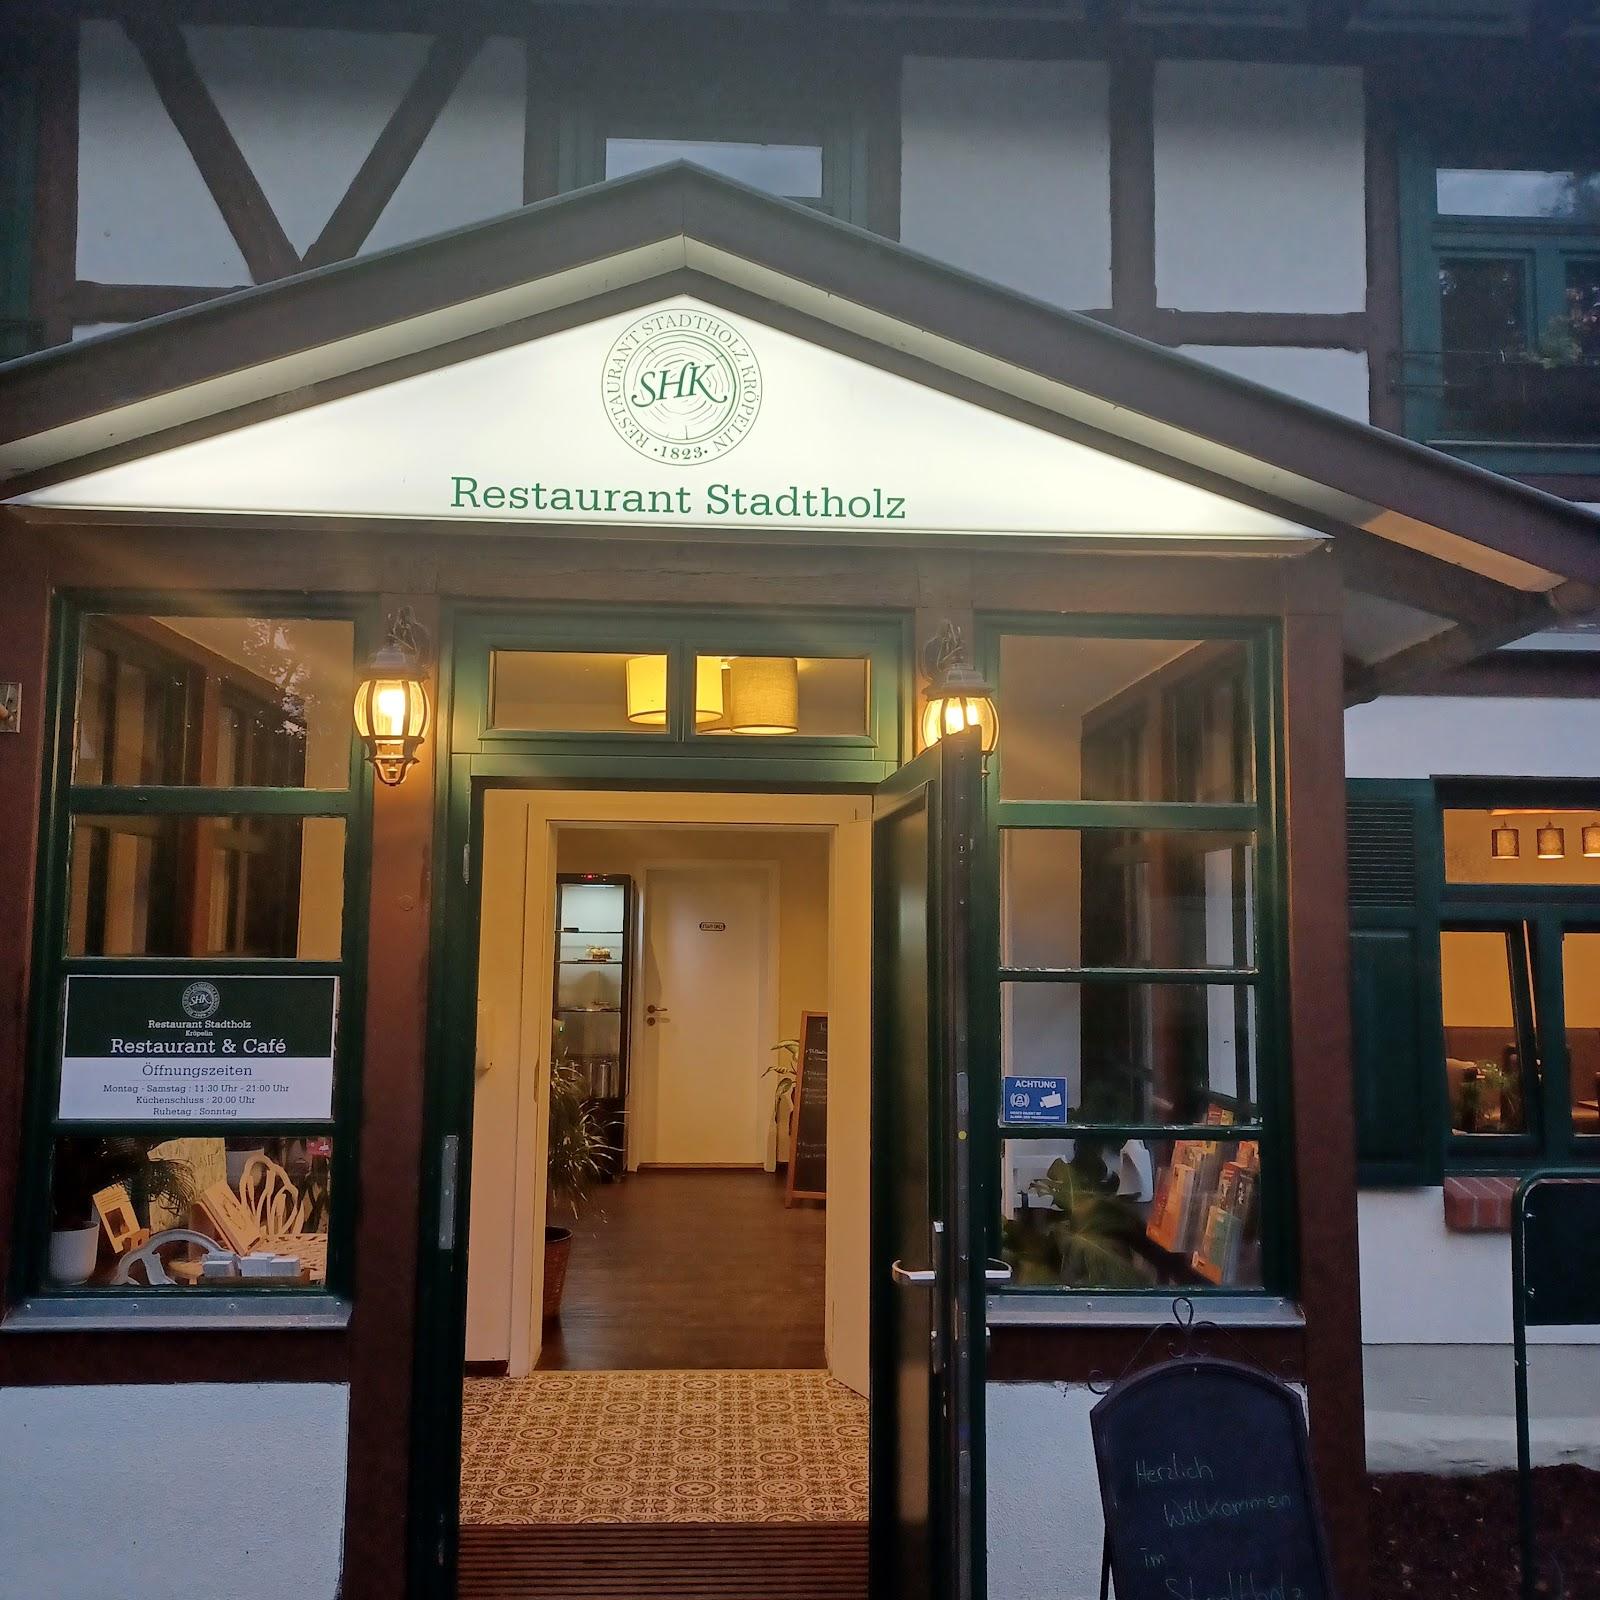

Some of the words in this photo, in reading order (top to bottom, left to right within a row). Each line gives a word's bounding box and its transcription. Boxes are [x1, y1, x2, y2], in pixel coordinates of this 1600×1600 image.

[607, 330, 650, 448] RESTAURANT
[641, 314, 749, 362] STADTHOLZ
[712, 365, 760, 451] KRÖPELIN
[631, 361, 728, 408] SHK
[450, 476, 692, 514] Restaurant
[706, 483, 906, 519] Stadtholz
[148, 1020, 203, 1029] Restaurant
[204, 1020, 252, 1029] Stadtholz
[110, 1038, 216, 1053] Restaurant
[221, 1039, 237, 1053] &
[243, 1038, 287, 1053] Café
[142, 1062, 253, 1078] Öffnungszeiten
[103, 1084, 139, 1094] Montag
[146, 1084, 186, 1094] Samstag
[221, 1084, 238, 1093] Uhr
[246, 1084, 271, 1093] 21:00
[273, 1084, 290, 1093] Uhr
[1015, 1080, 1057, 1088] ACHTUNG
[136, 1096, 204, 1104] Küchenschluss
[239, 1096, 256, 1104] Uhr
[153, 1107, 192, 1117] Ruhetag
[199, 1107, 237, 1117] Sonntag
[1135, 1453, 1214, 1488] Herzlich
[1163, 1495, 1292, 1528] Willkommen
[1165, 1571, 1305, 1600] Stdtholz
